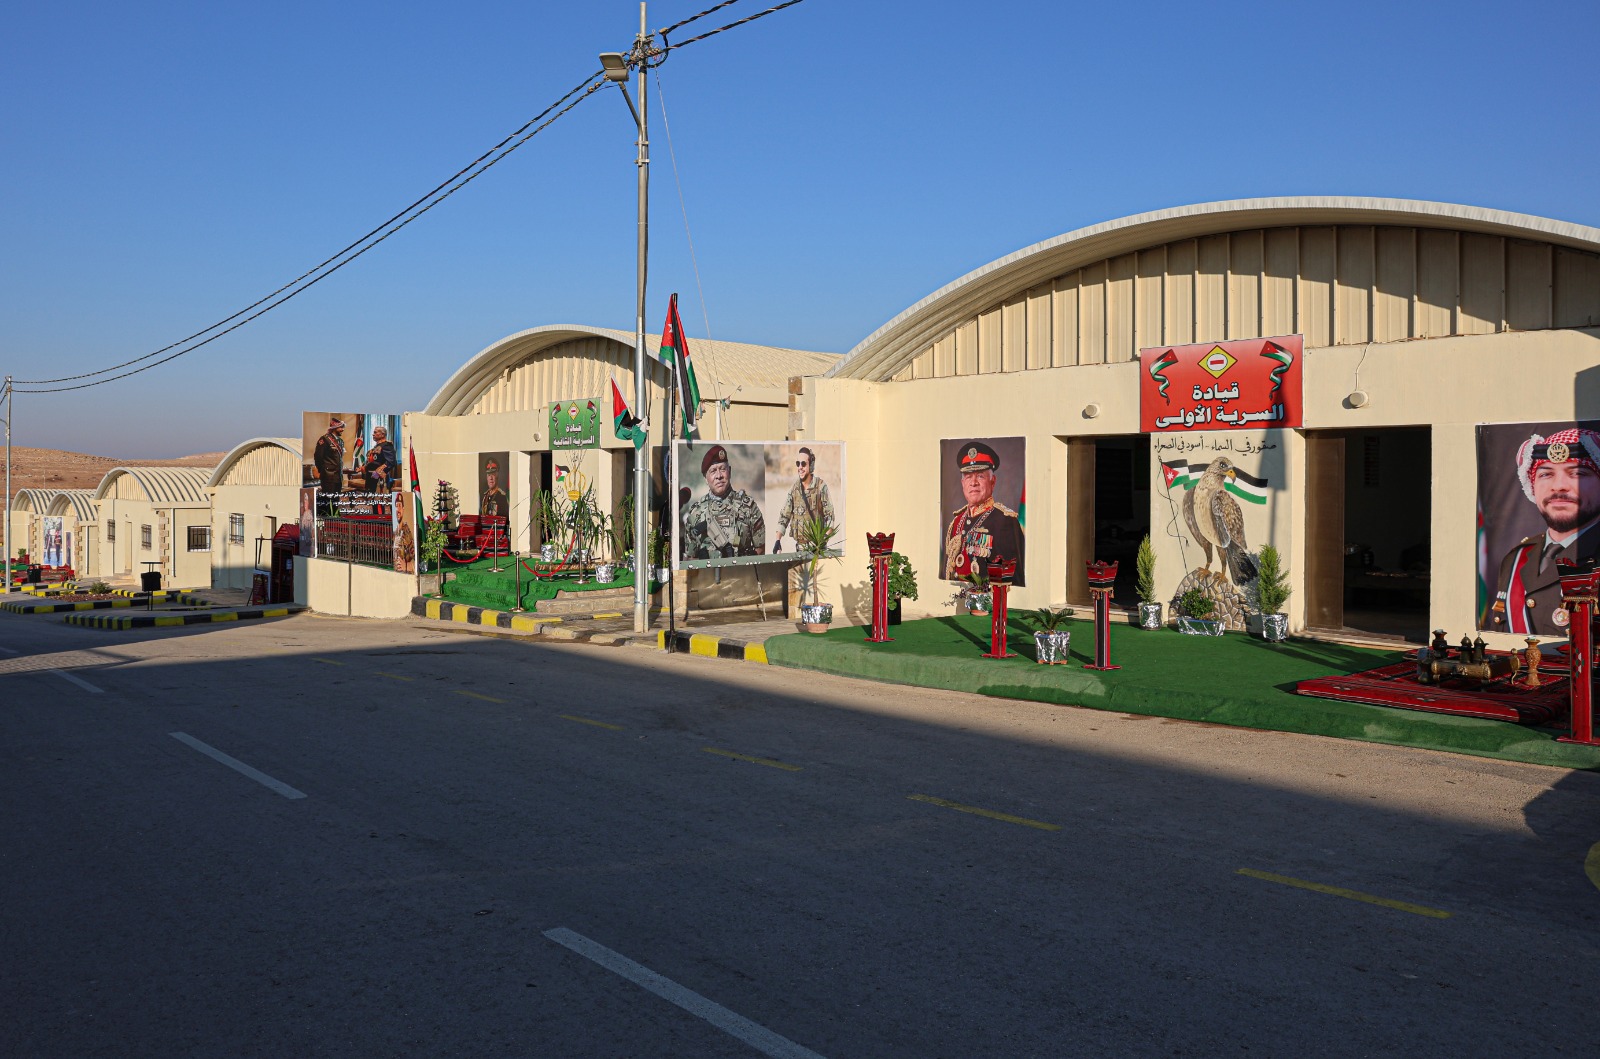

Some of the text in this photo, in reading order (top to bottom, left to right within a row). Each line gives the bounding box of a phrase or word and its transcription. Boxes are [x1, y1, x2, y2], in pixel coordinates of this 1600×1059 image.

[1192, 381, 1240, 402] قيادة
[1155, 403, 1284, 428] السرية الأولى
[566, 422, 582, 434] قيادة
[553, 435, 595, 448] السرية الثانية
[1154, 438, 1177, 453] الصحراء
[1177, 436, 1185, 453] في
[1186, 435, 1204, 451] أسود
[1211, 439, 1233, 451] السماء
[1235, 436, 1251, 456] في
[1250, 440, 1277, 453] صقور
